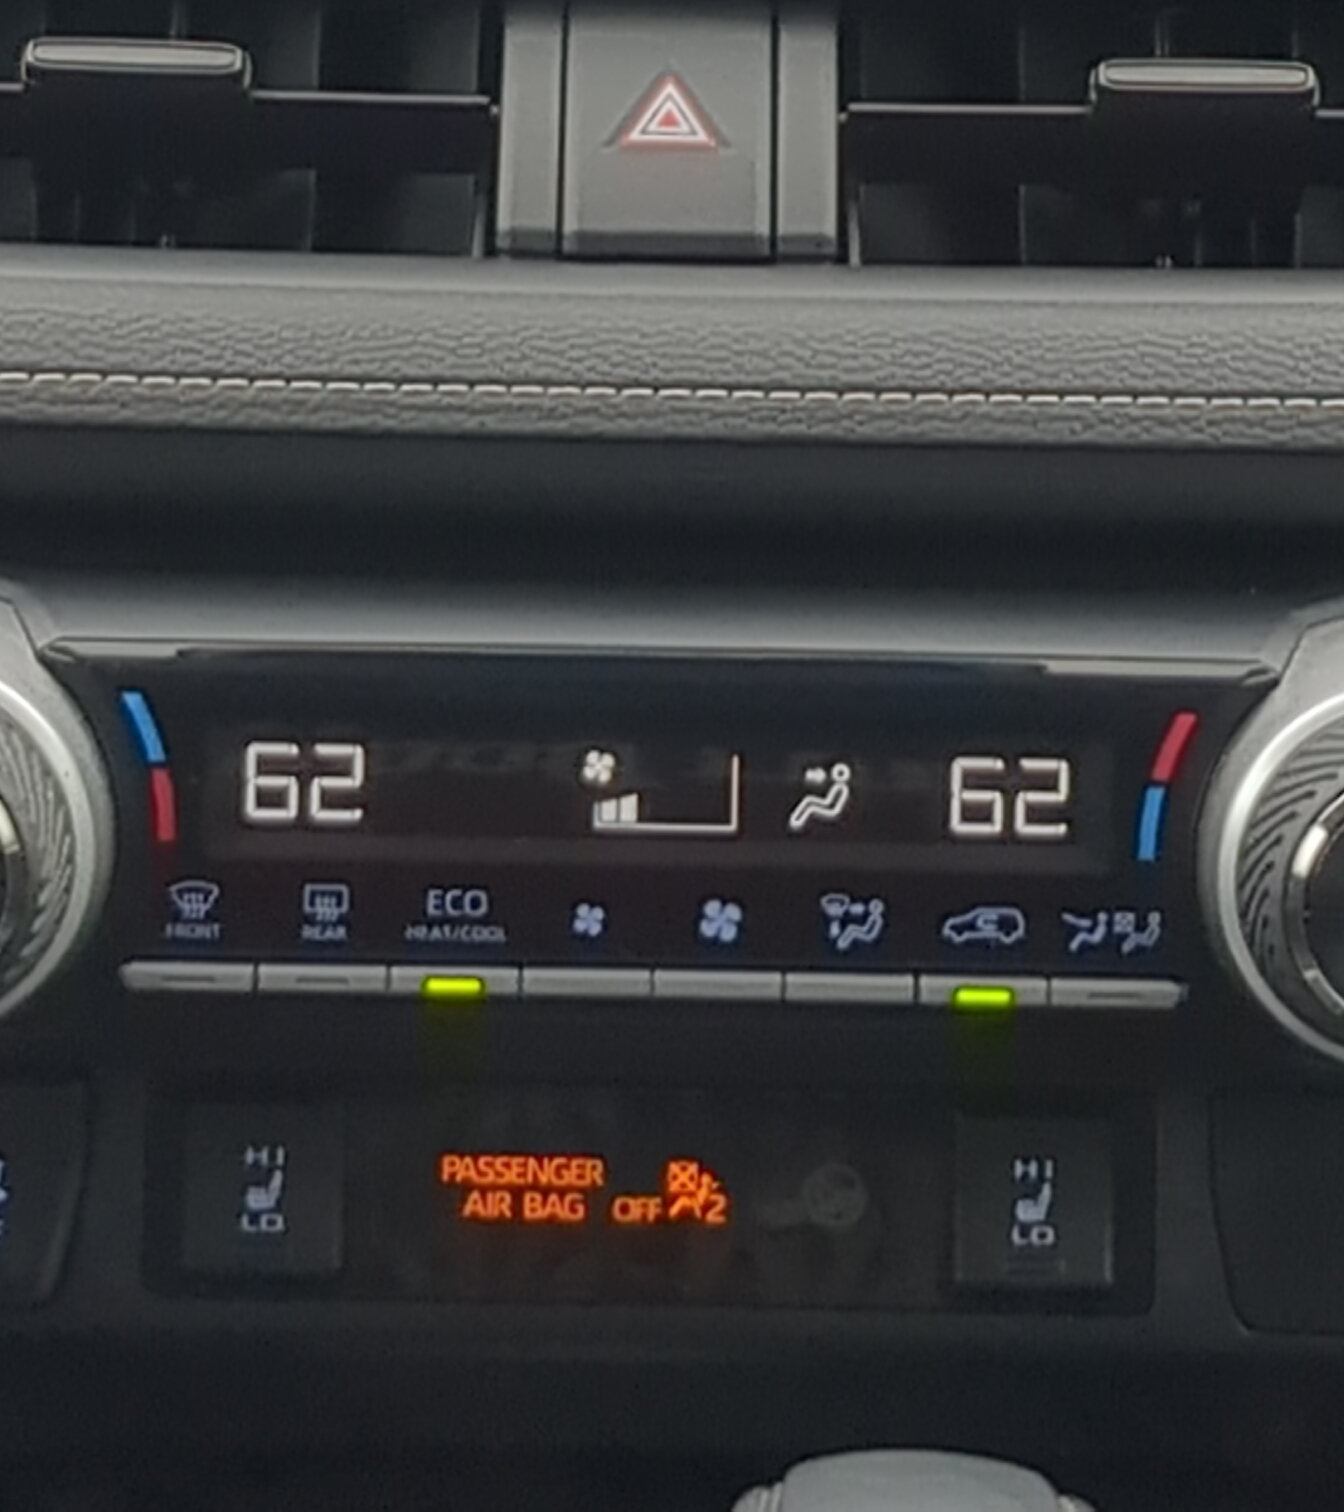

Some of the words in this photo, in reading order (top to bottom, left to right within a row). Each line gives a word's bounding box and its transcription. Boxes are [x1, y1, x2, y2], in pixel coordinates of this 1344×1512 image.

[243, 741, 365, 822] 62
[949, 757, 1070, 838] 62
[427, 890, 489, 917] ECO
[166, 923, 221, 939] FRONT
[301, 925, 346, 940] REAR
[441, 1155, 603, 1185] PASSENGER
[463, 1192, 511, 1218] AIR
[523, 1193, 585, 1220] BAG
[612, 1197, 661, 1222] OFF
